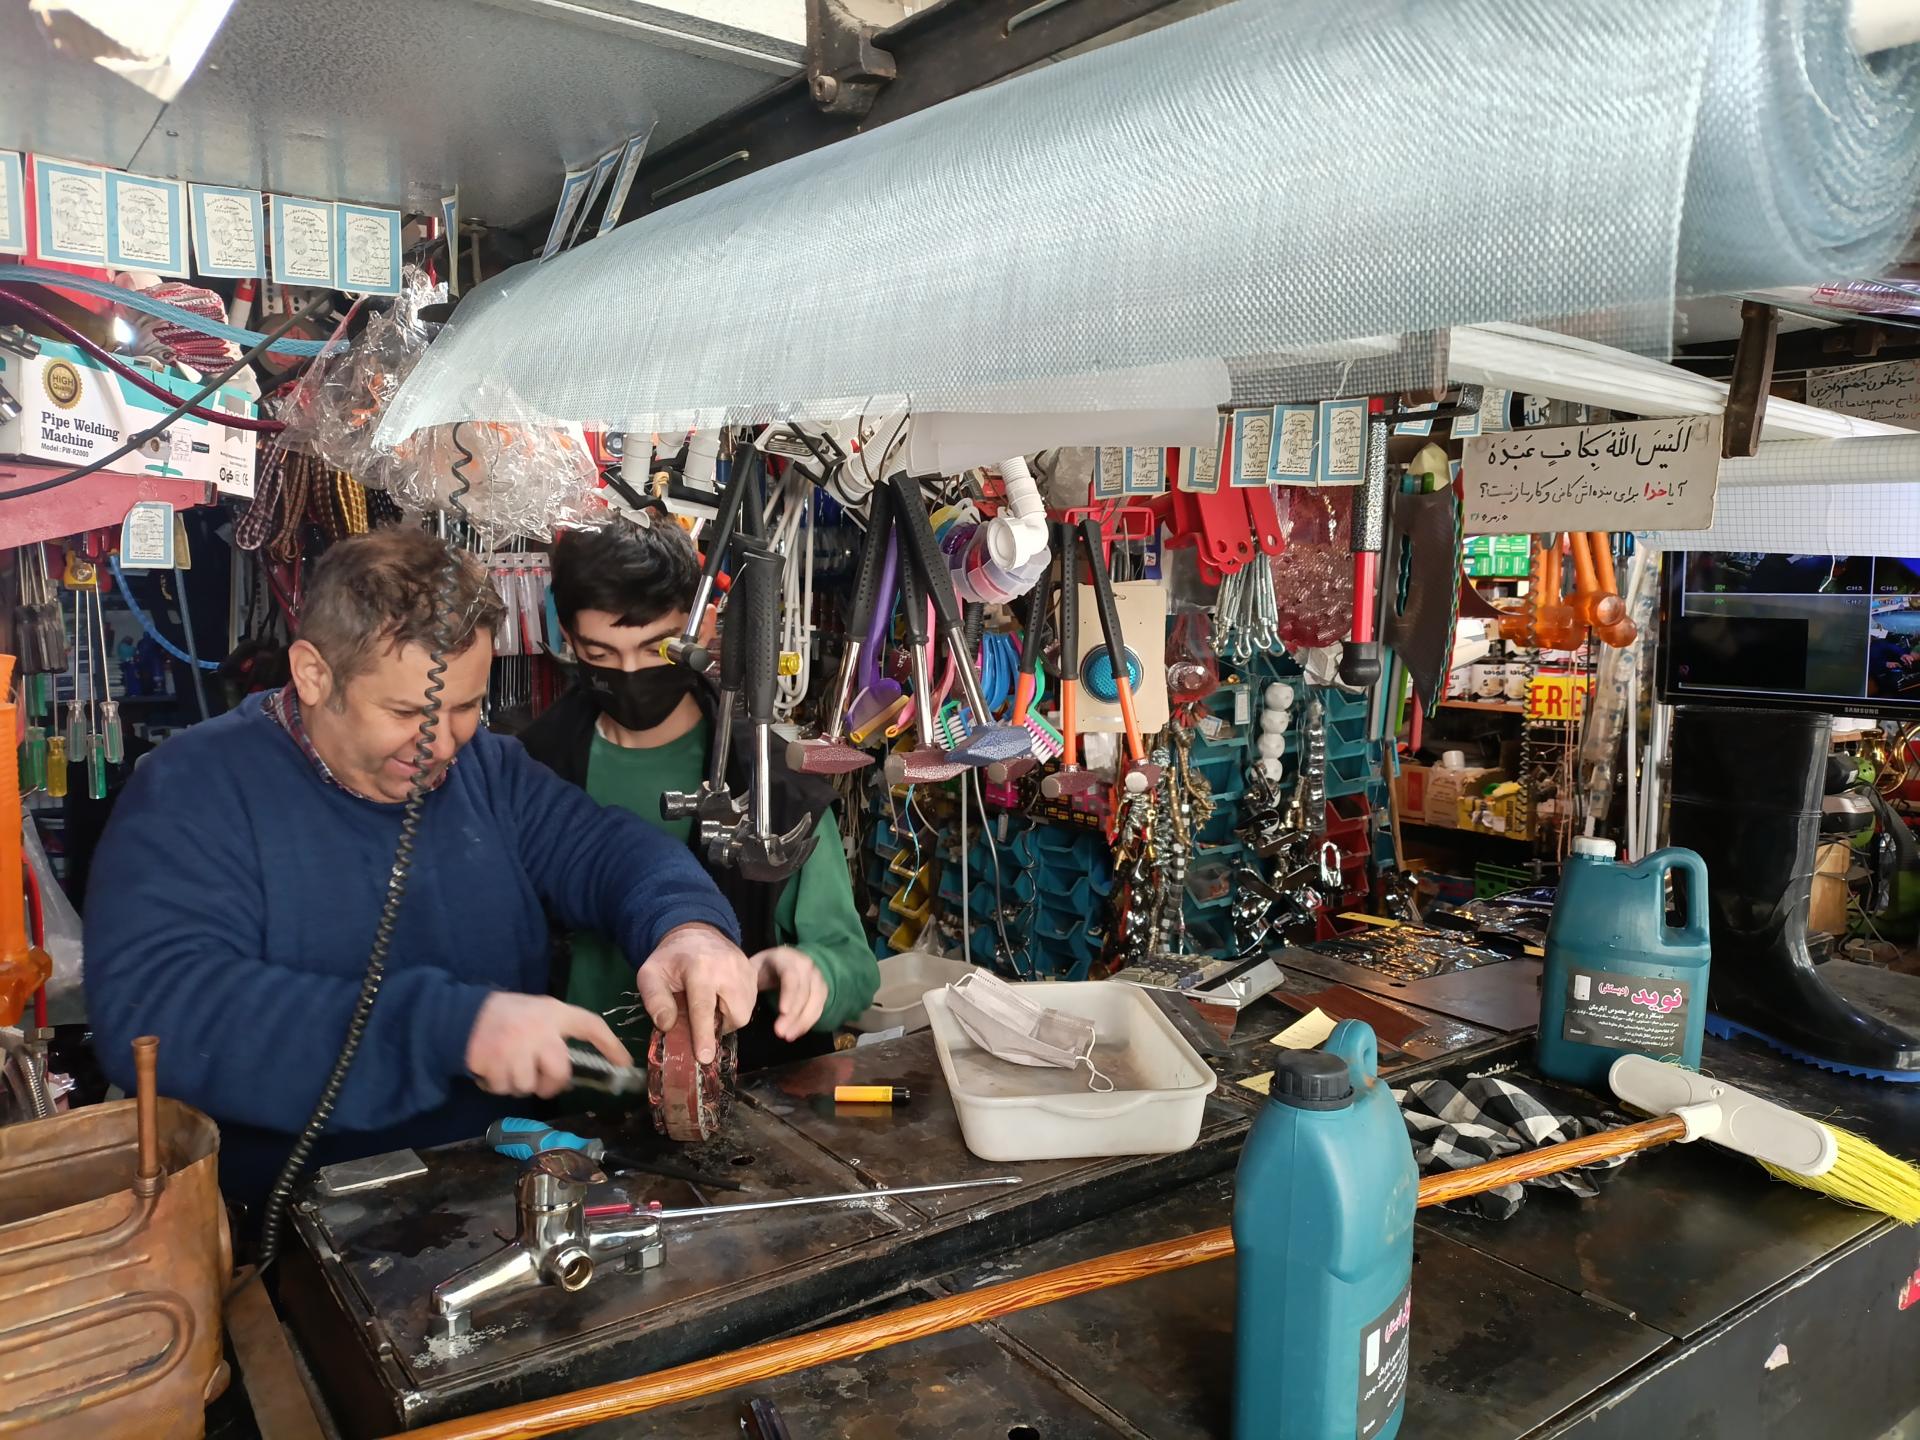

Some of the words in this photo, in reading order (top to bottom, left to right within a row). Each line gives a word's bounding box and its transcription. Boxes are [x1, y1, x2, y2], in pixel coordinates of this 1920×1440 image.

[53, 374, 74, 387] HIGH
[41, 411, 70, 430] Pipe
[74, 418, 120, 442] Welding
[41, 427, 94, 449] Machine
[41, 443, 59, 453] Model
[1614, 486, 1639, 504] برای
[1643, 481, 1667, 501] خدا
[1844, 706, 1880, 715] SAMSUNG
[1631, 987, 1683, 1014] نوید
